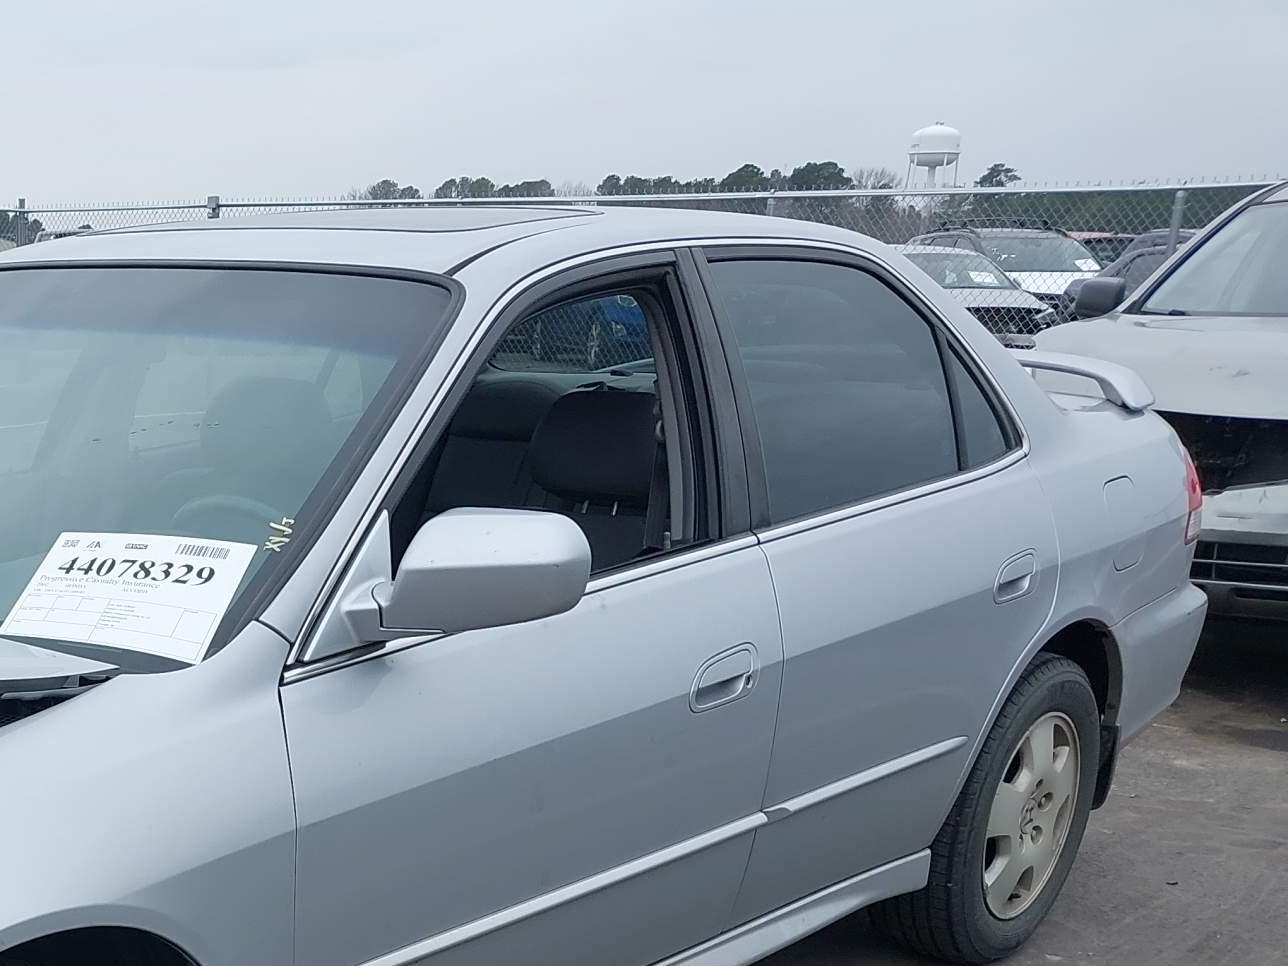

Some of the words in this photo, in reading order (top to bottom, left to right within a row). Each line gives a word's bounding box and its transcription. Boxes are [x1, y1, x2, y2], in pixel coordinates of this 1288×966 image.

[39, 574, 84, 584] Progressive
[85, 577, 119, 585] Casualty
[121, 579, 161, 589] Insurance
[57, 556, 215, 586] 44078329
